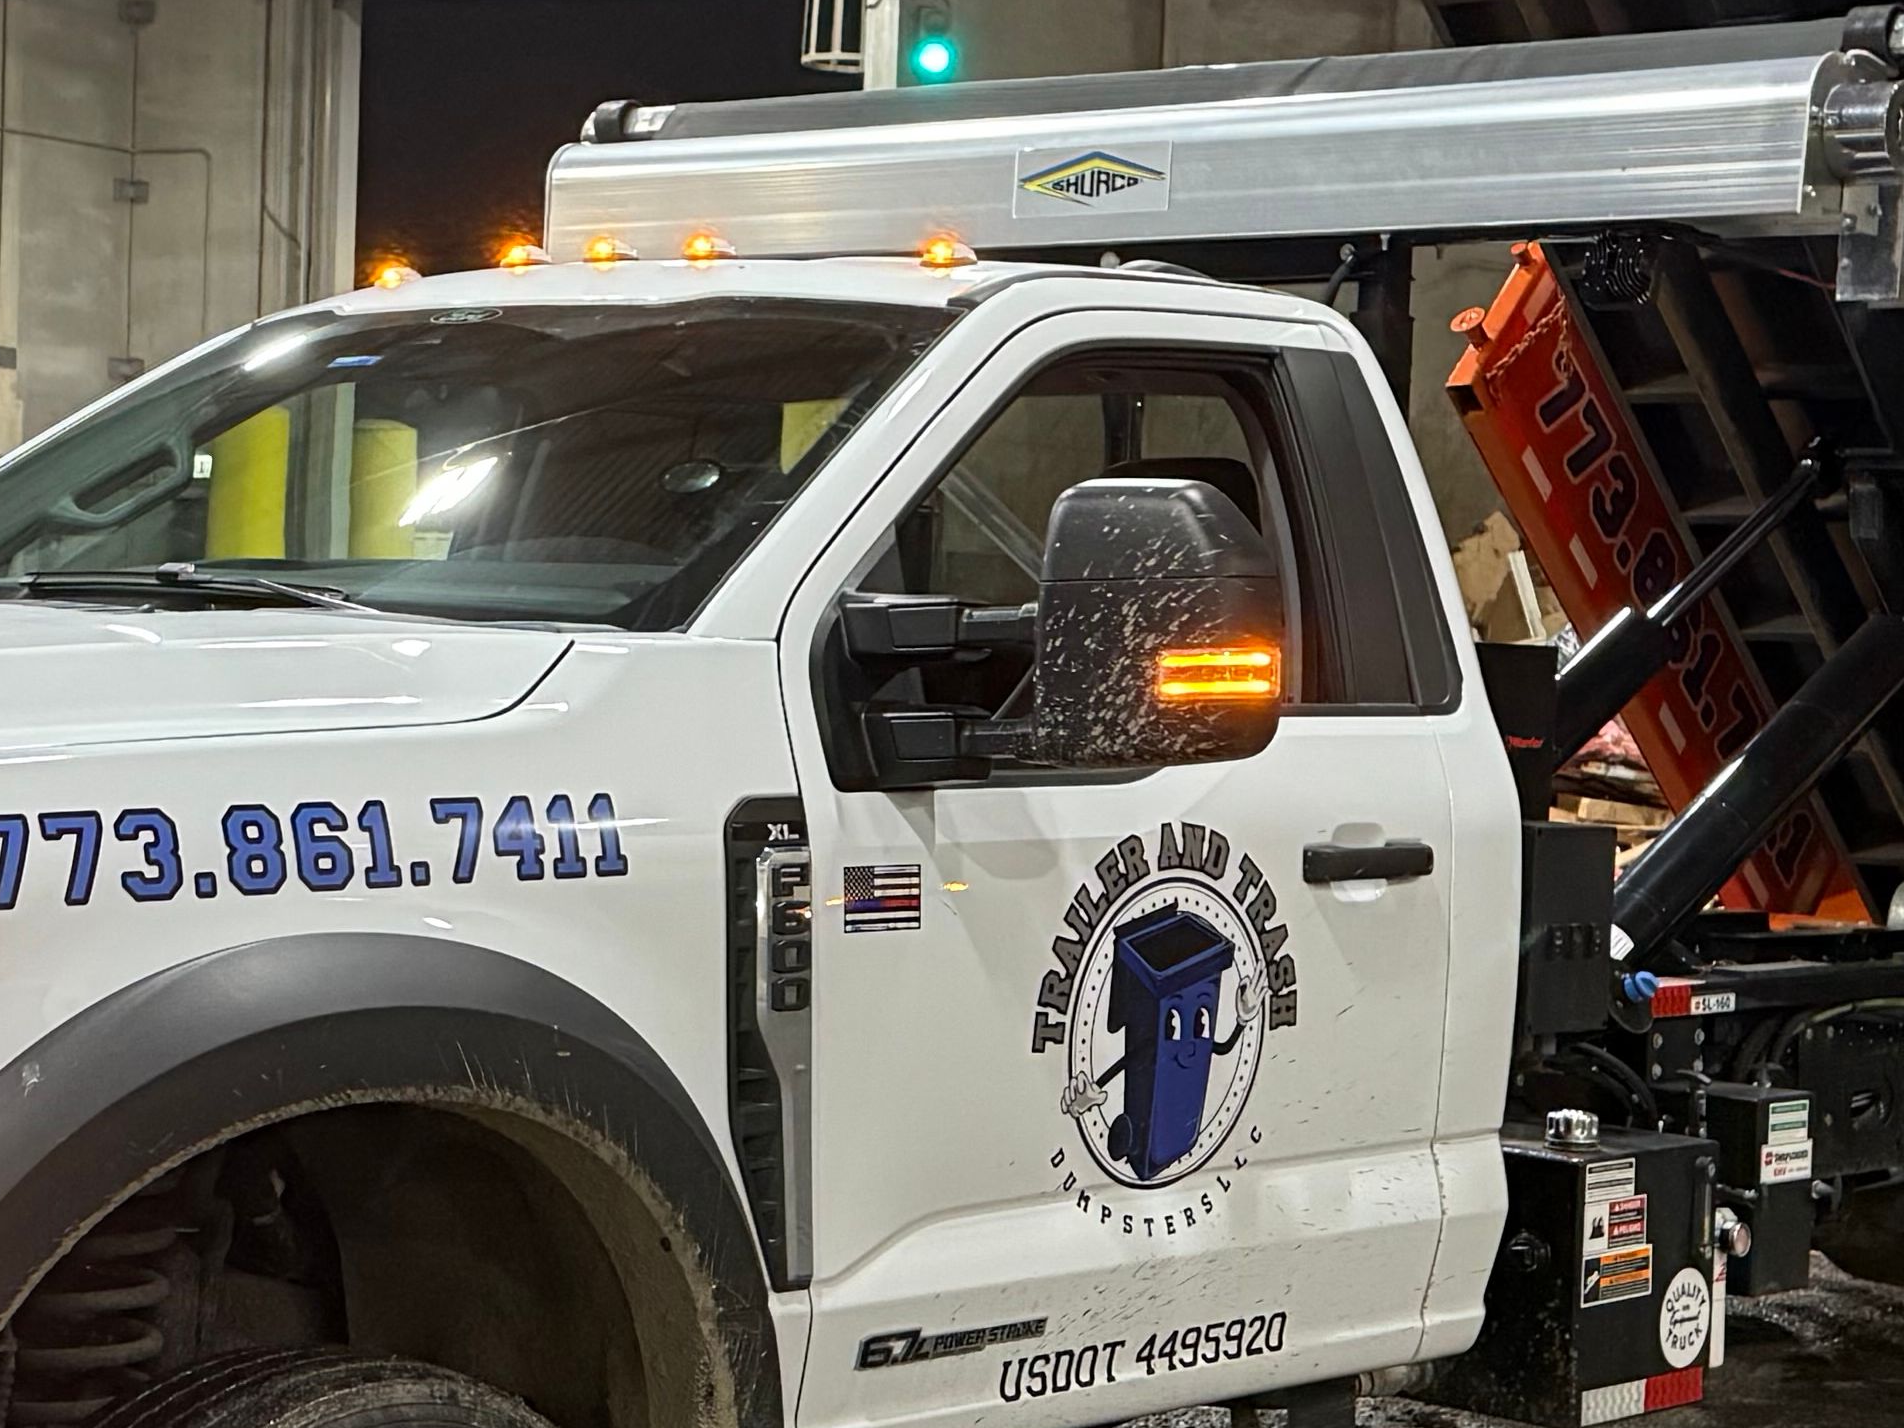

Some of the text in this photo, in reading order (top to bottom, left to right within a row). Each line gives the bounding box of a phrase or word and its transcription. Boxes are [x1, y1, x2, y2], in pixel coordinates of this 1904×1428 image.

[1052, 170, 1139, 197] SHURCO
[767, 823, 799, 840] XL
[1032, 821, 1298, 1053] TRAILER AND TRASH
[1050, 1125, 1263, 1237] DUMPSTERS LLC
[1665, 1282, 1706, 1314] QUALITY
[1666, 1327, 1703, 1351] TRUCK
[1000, 1311, 1287, 1403] USDOT 4495920
